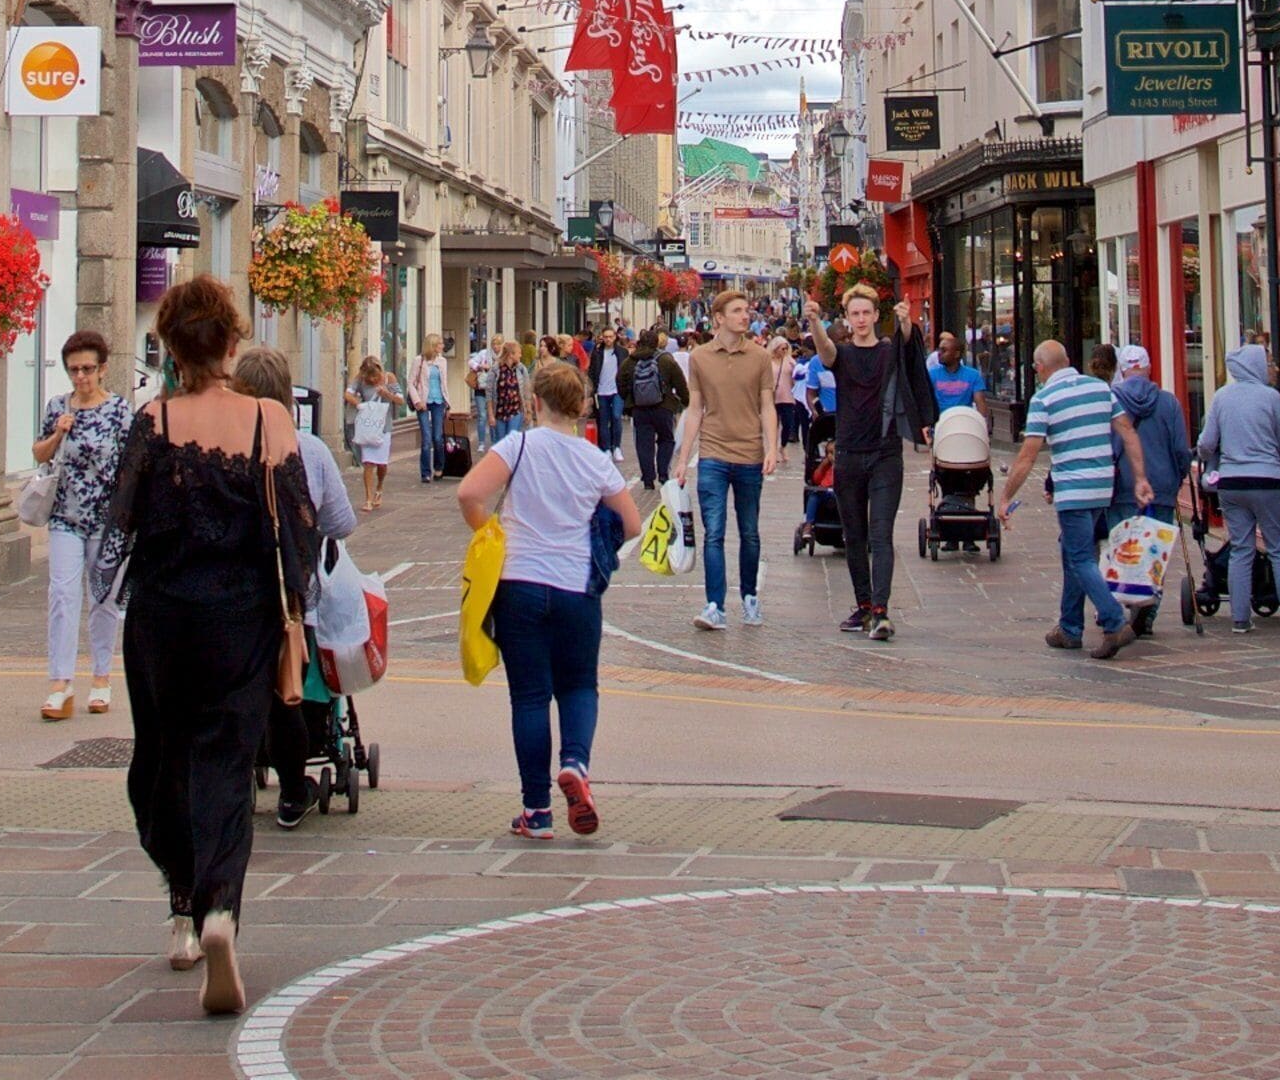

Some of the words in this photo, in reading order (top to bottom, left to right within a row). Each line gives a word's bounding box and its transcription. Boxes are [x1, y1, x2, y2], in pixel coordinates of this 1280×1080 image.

[140, 13, 224, 46] Blush
[1127, 41, 1219, 59] RIVOLI
[1135, 75, 1213, 92] Jewellers
[1130, 98, 1159, 108] 41/43
[1162, 97, 1185, 109] King
[1186, 97, 1218, 107] Street
[891, 109, 910, 120] Jack
[911, 108, 933, 118] Wills
[1006, 173, 1038, 191] JACK
[1044, 170, 1082, 188] WIL
[660, 242, 684, 252] USC
